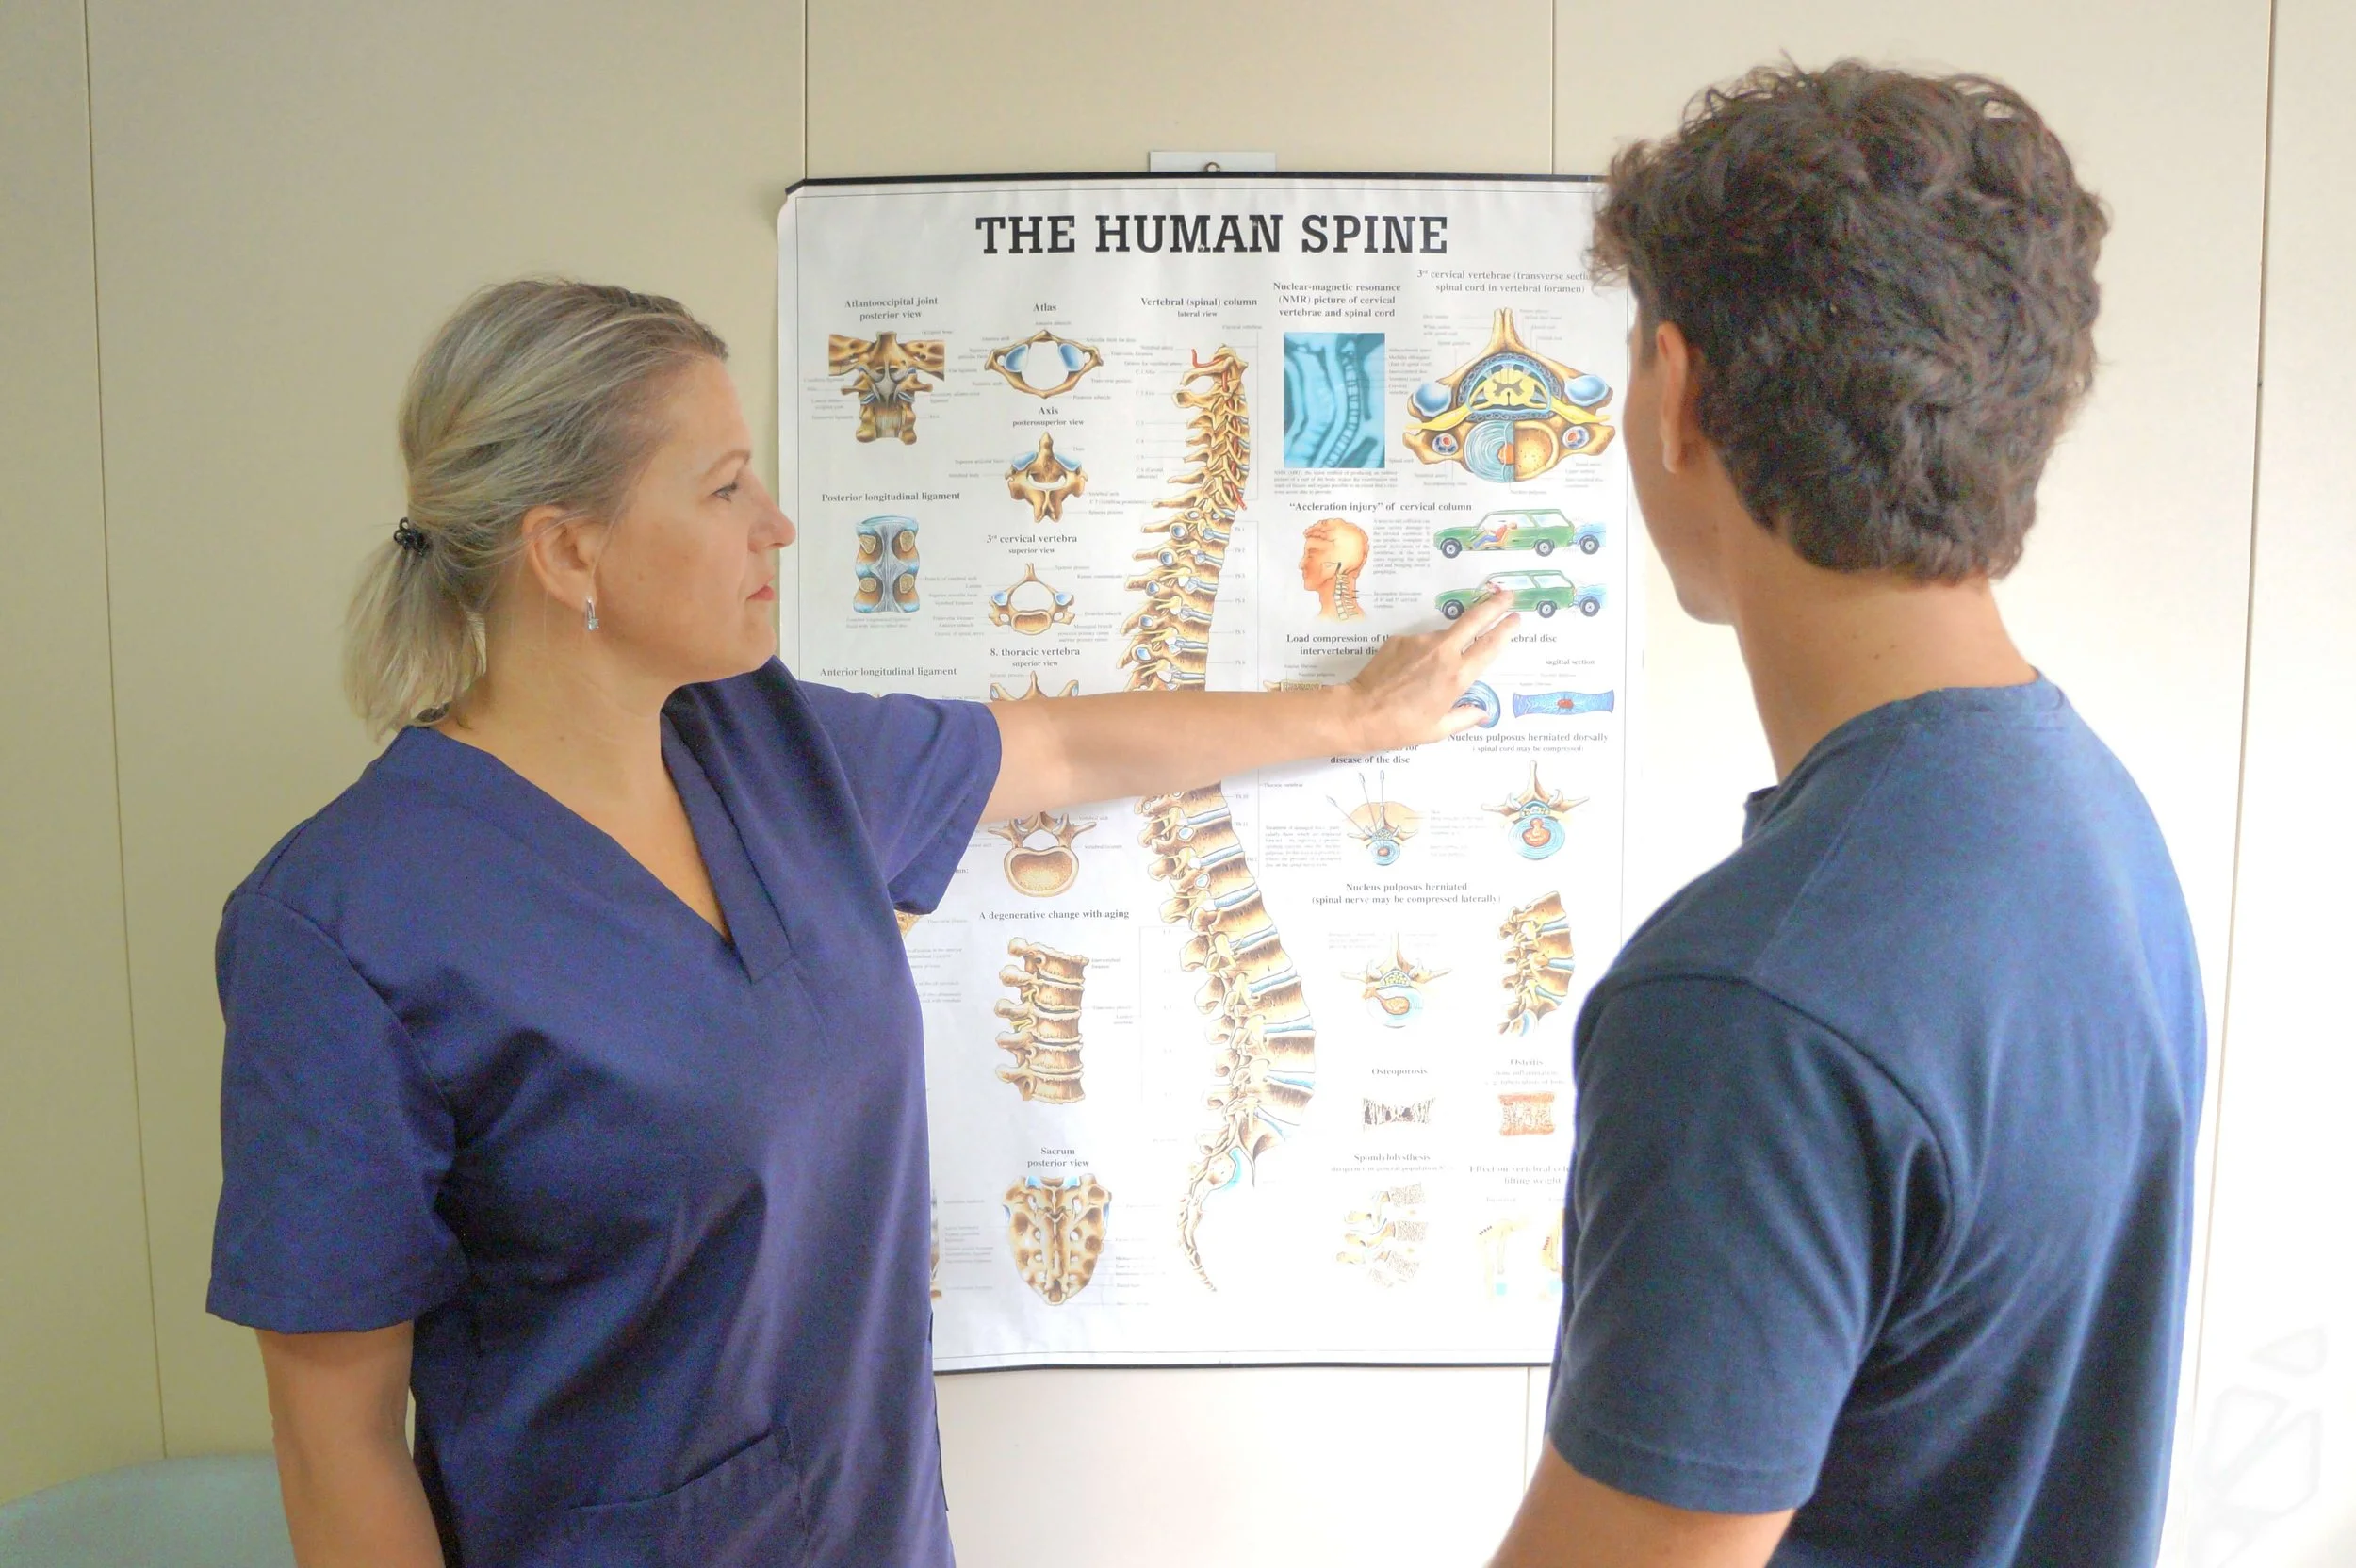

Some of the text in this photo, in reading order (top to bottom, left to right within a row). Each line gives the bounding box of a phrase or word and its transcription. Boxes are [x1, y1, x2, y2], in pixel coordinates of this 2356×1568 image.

[975, 214, 1447, 254] THE HUMAN SPINE
[1430, 270, 1466, 279] cervical
[1467, 270, 1512, 280] vertebrae
[1513, 270, 1564, 280] (transverse
[1273, 282, 1353, 292] Nuclear-magnetic
[1435, 282, 1585, 293] spinal cord in vertebral foramen)
[844, 296, 939, 308] Atlantooccipital joint
[1140, 297, 1258, 308] Vertebral (spinal) column
[1278, 294, 1396, 305] (NMR) picture of cervical
[1032, 302, 1057, 312] Atlas
[859, 309, 923, 322] posterior view
[1278, 307, 1396, 318] vertebrae and spinal cord
[1038, 405, 1059, 415] Axis
[1012, 418, 1068, 428] posterosuperior
[821, 491, 961, 502] Posterior longitudinal ligament
[1385, 501, 1396, 511] of
[1399, 501, 1436, 511] cervical
[1438, 501, 1472, 511] column
[999, 533, 1036, 543] cervical
[1038, 533, 1078, 543] vertebra
[1008, 547, 1039, 556] superior
[1285, 633, 1310, 643] Load
[1313, 634, 1367, 644] compression
[1370, 634, 1380, 643] of
[1510, 633, 1558, 643] ebral disc
[1001, 647, 1039, 657] thoracic
[1041, 646, 1081, 656] vertebra
[1301, 647, 1362, 656] intervertebral
[1545, 658, 1571, 667] sagittal
[820, 664, 957, 678] Anterior longitudinal ligament
[1449, 732, 1608, 743] Nucleus pulposus herniated dorsally
[1330, 756, 1362, 764] disease
[1346, 882, 1467, 892] Nucleus pulposus herniated
[1311, 895, 1342, 906] (spinal
[1371, 897, 1391, 906] may
[1396, 895, 1404, 904] be
[1407, 896, 1458, 906] compressed
[979, 908, 1130, 921] A degenerative change with aging
[1371, 1068, 1428, 1077] Osteoporosis
[1040, 1147, 1075, 1155] Sacrum
[1026, 1158, 1068, 1168] posterior
